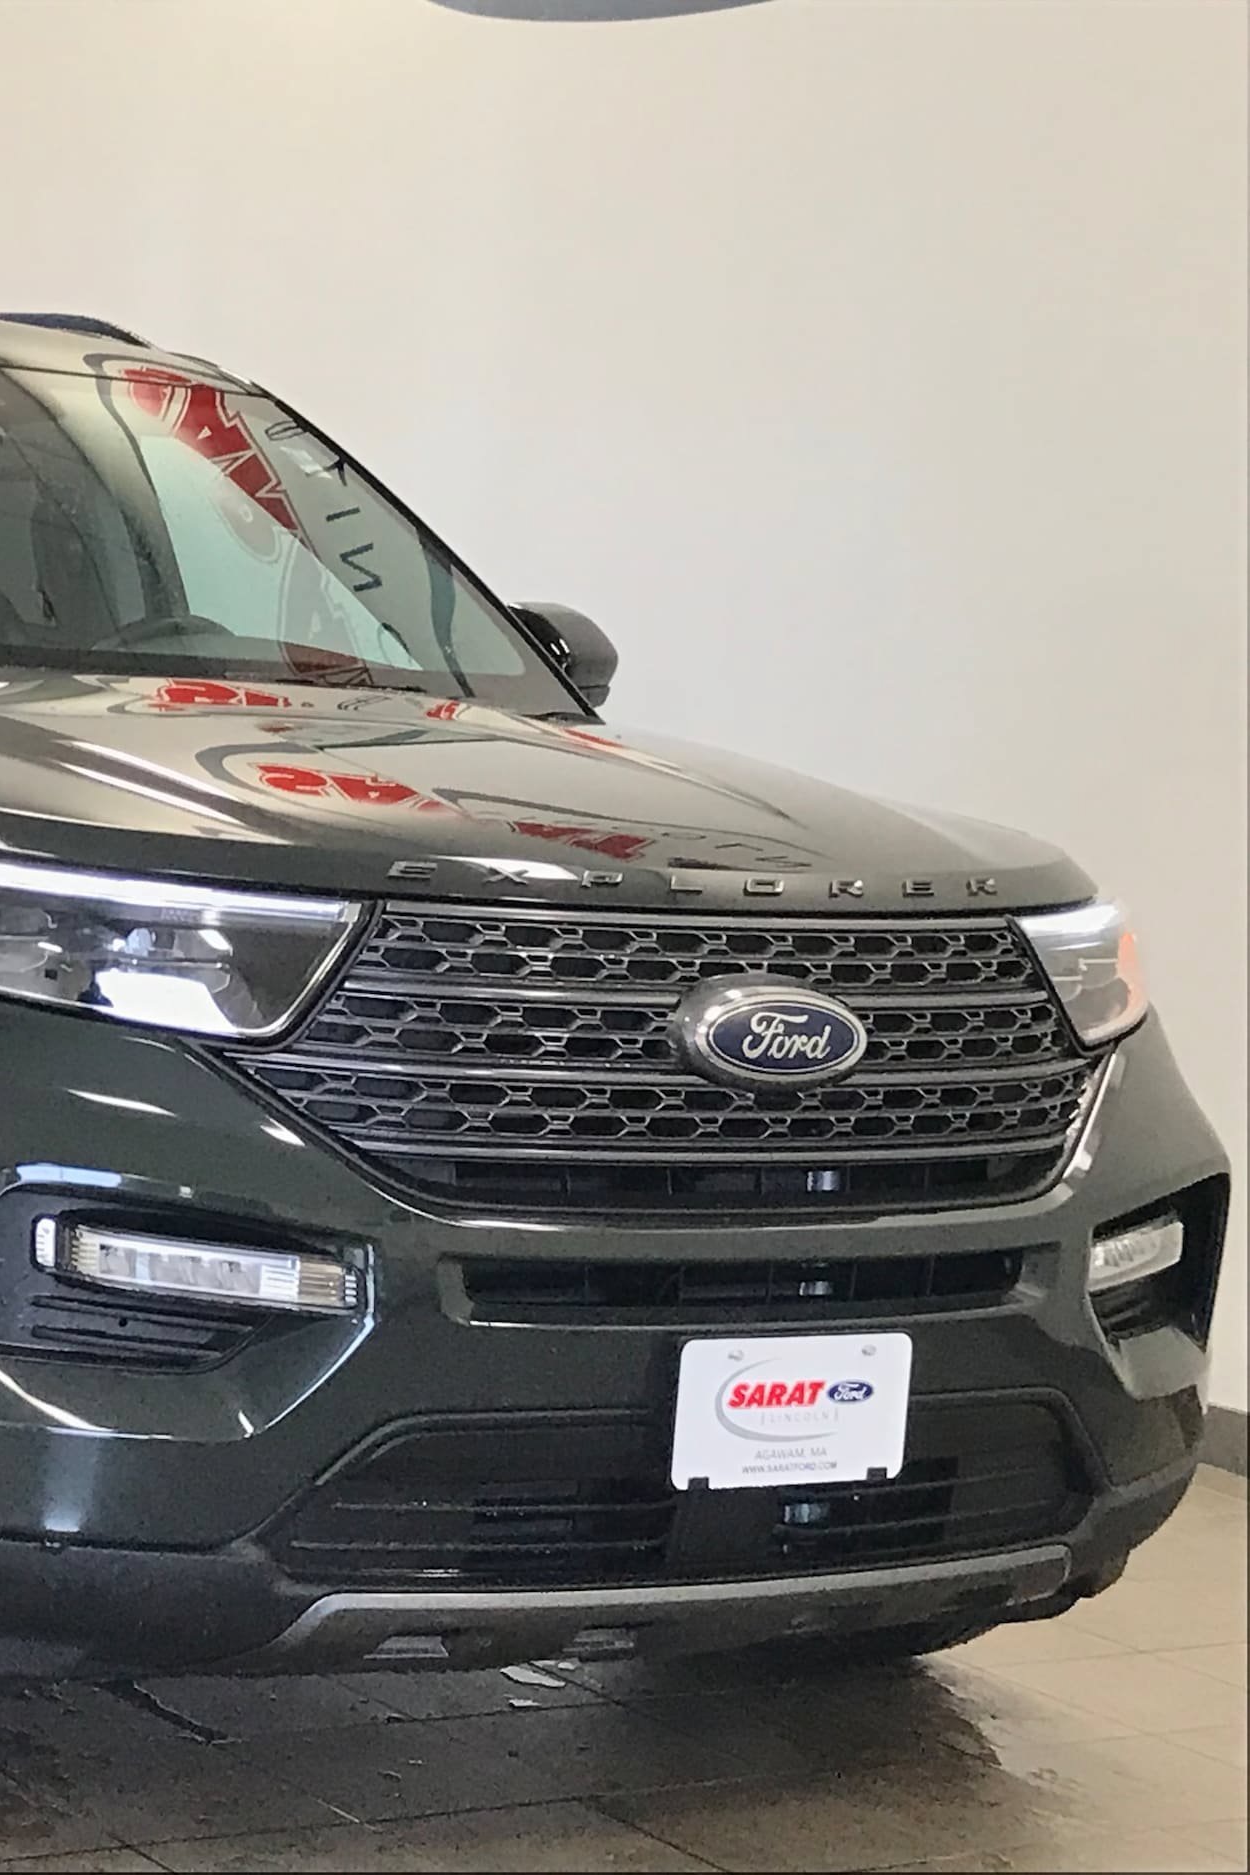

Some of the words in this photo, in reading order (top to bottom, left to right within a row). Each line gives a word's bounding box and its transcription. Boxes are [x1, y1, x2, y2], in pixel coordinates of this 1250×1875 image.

[387, 859, 999, 898] EXPLORER
[742, 1010, 832, 1062] Ford
[727, 1381, 826, 1409] SARAT
[832, 1380, 870, 1402] Ford
[810, 1446, 827, 1457] MA
